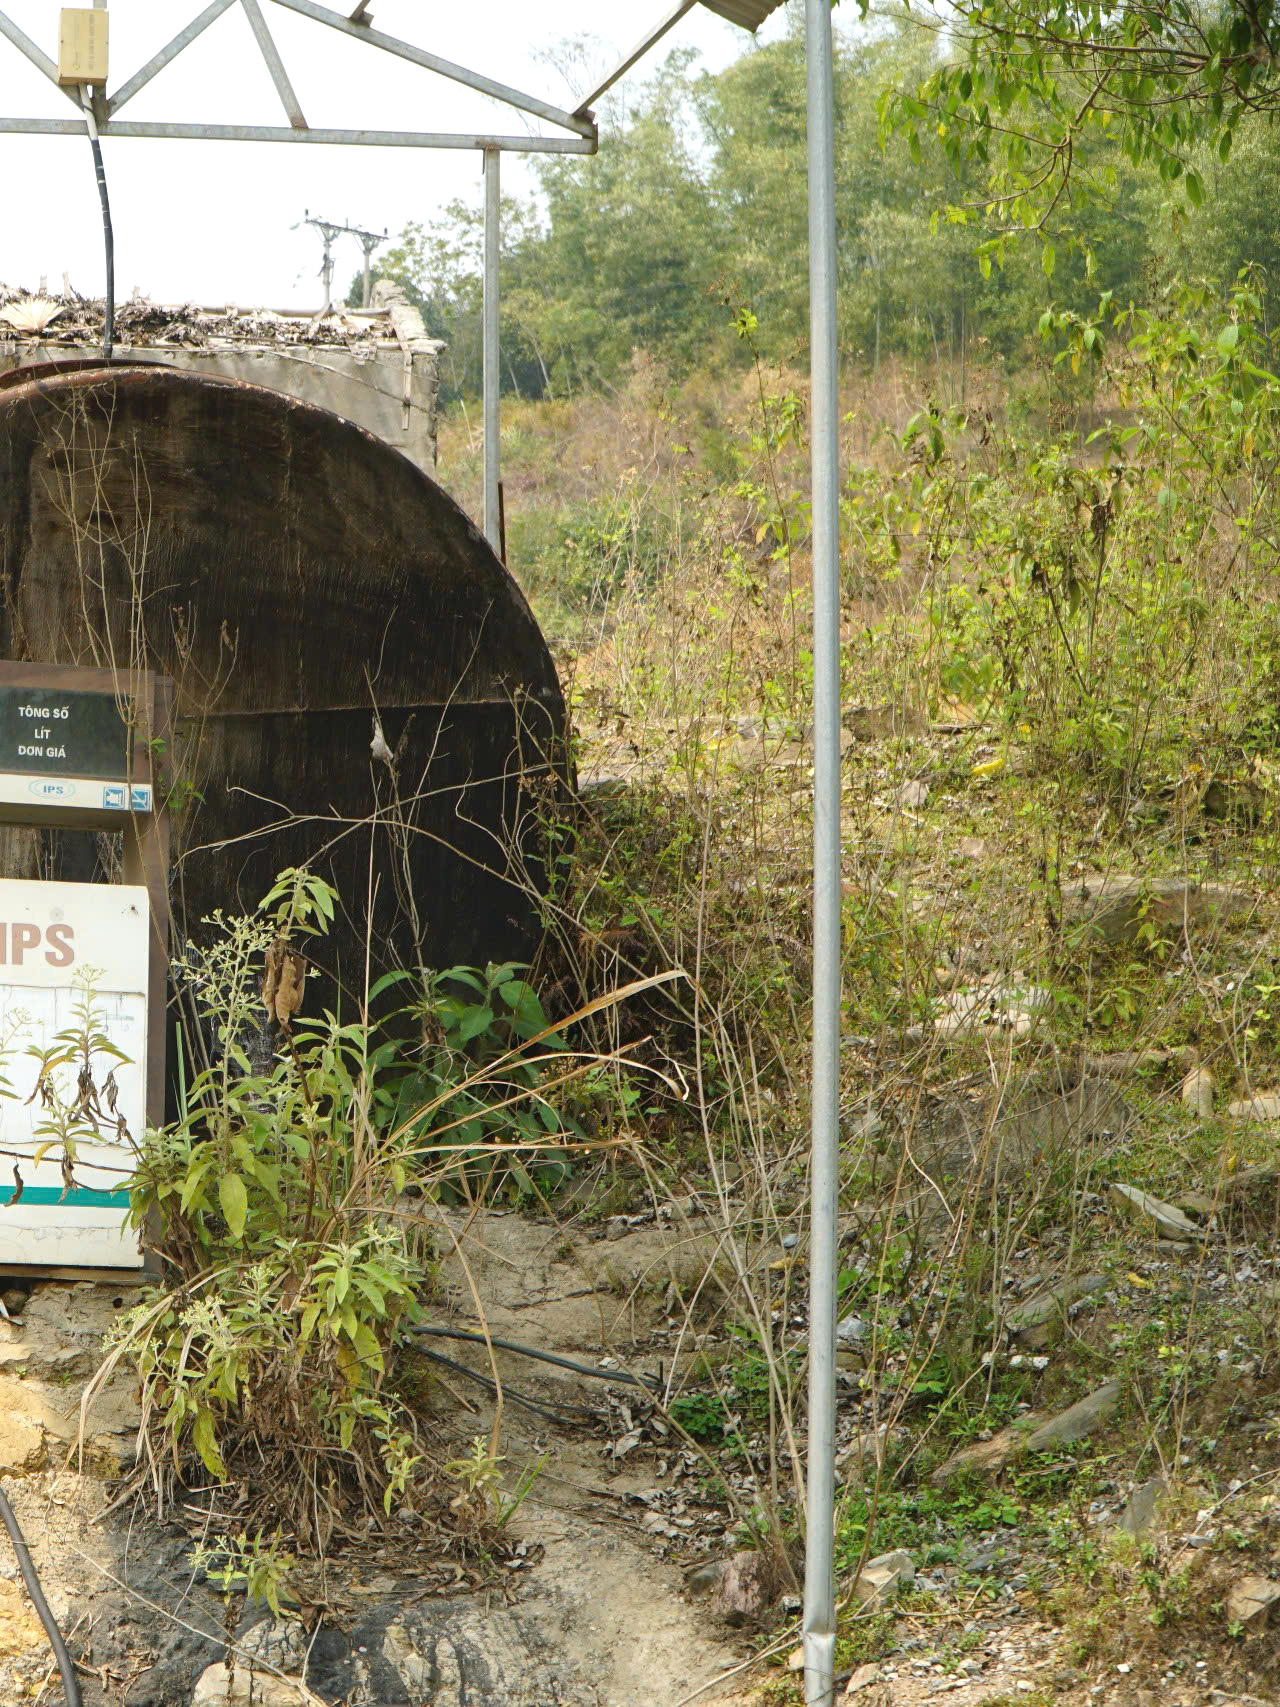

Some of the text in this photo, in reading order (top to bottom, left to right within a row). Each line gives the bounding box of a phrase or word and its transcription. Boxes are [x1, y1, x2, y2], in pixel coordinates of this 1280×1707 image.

[53, 706, 69, 719] SỐ
[34, 726, 51, 739] LÍT
[18, 745, 66, 758] ĐƠN GIÁ
[43, 784, 64, 795] IPS
